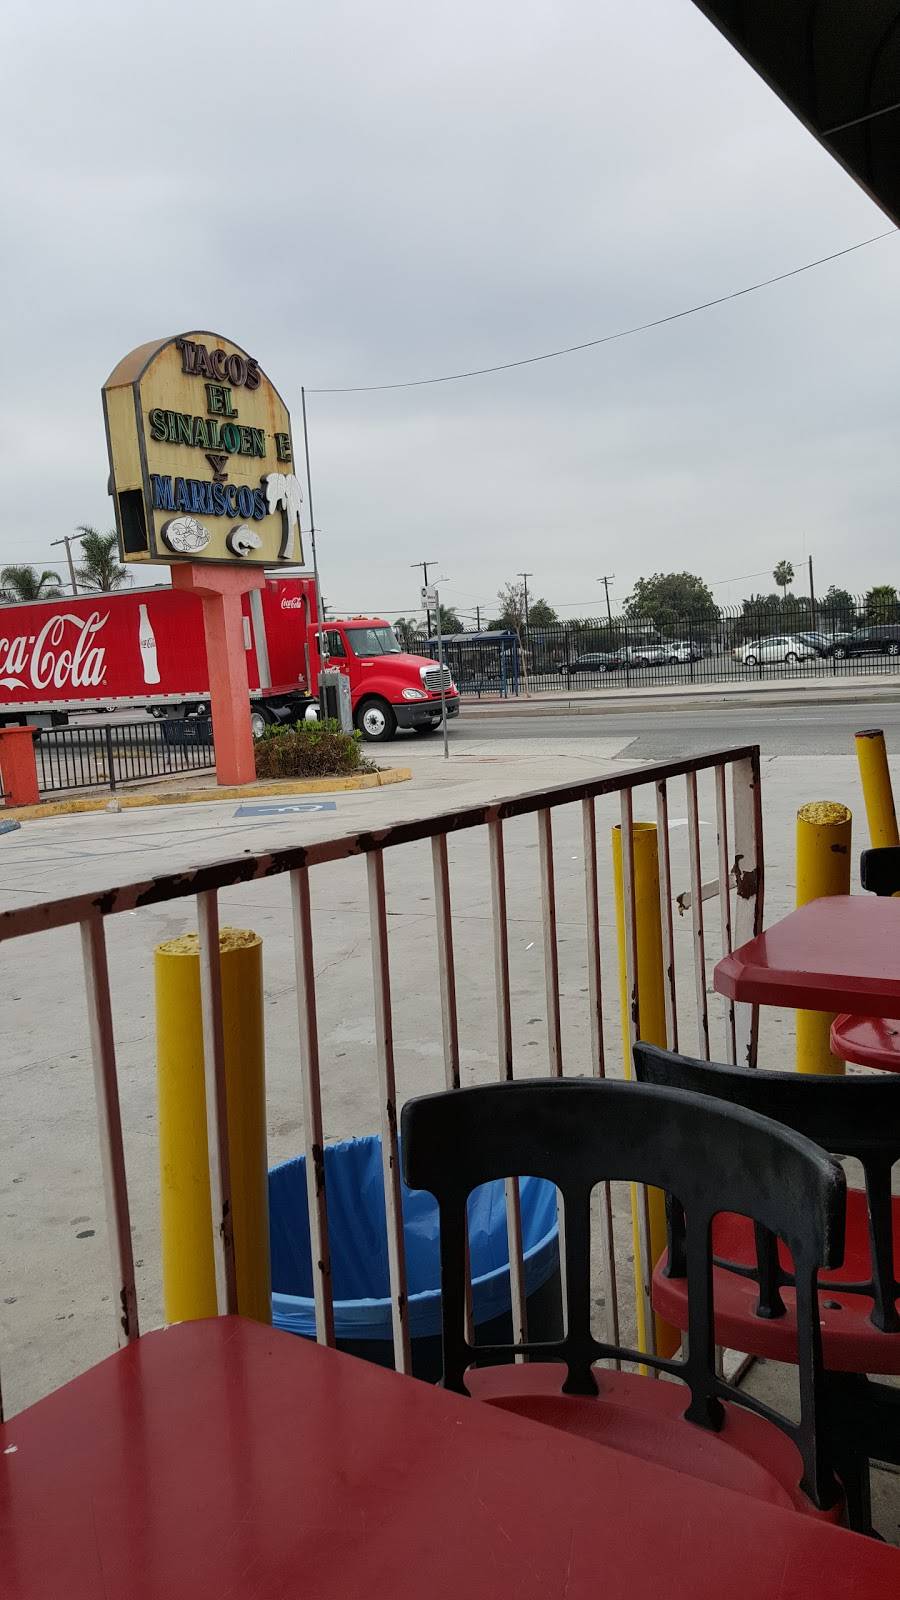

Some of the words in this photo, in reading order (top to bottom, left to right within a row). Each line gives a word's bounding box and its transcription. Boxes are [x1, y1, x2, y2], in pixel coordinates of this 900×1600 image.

[178, 339, 260, 390] TACOS
[205, 383, 238, 418] EL
[150, 408, 266, 458] SINALOEN
[205, 454, 229, 481] Y
[150, 474, 267, 520] MARISCOS
